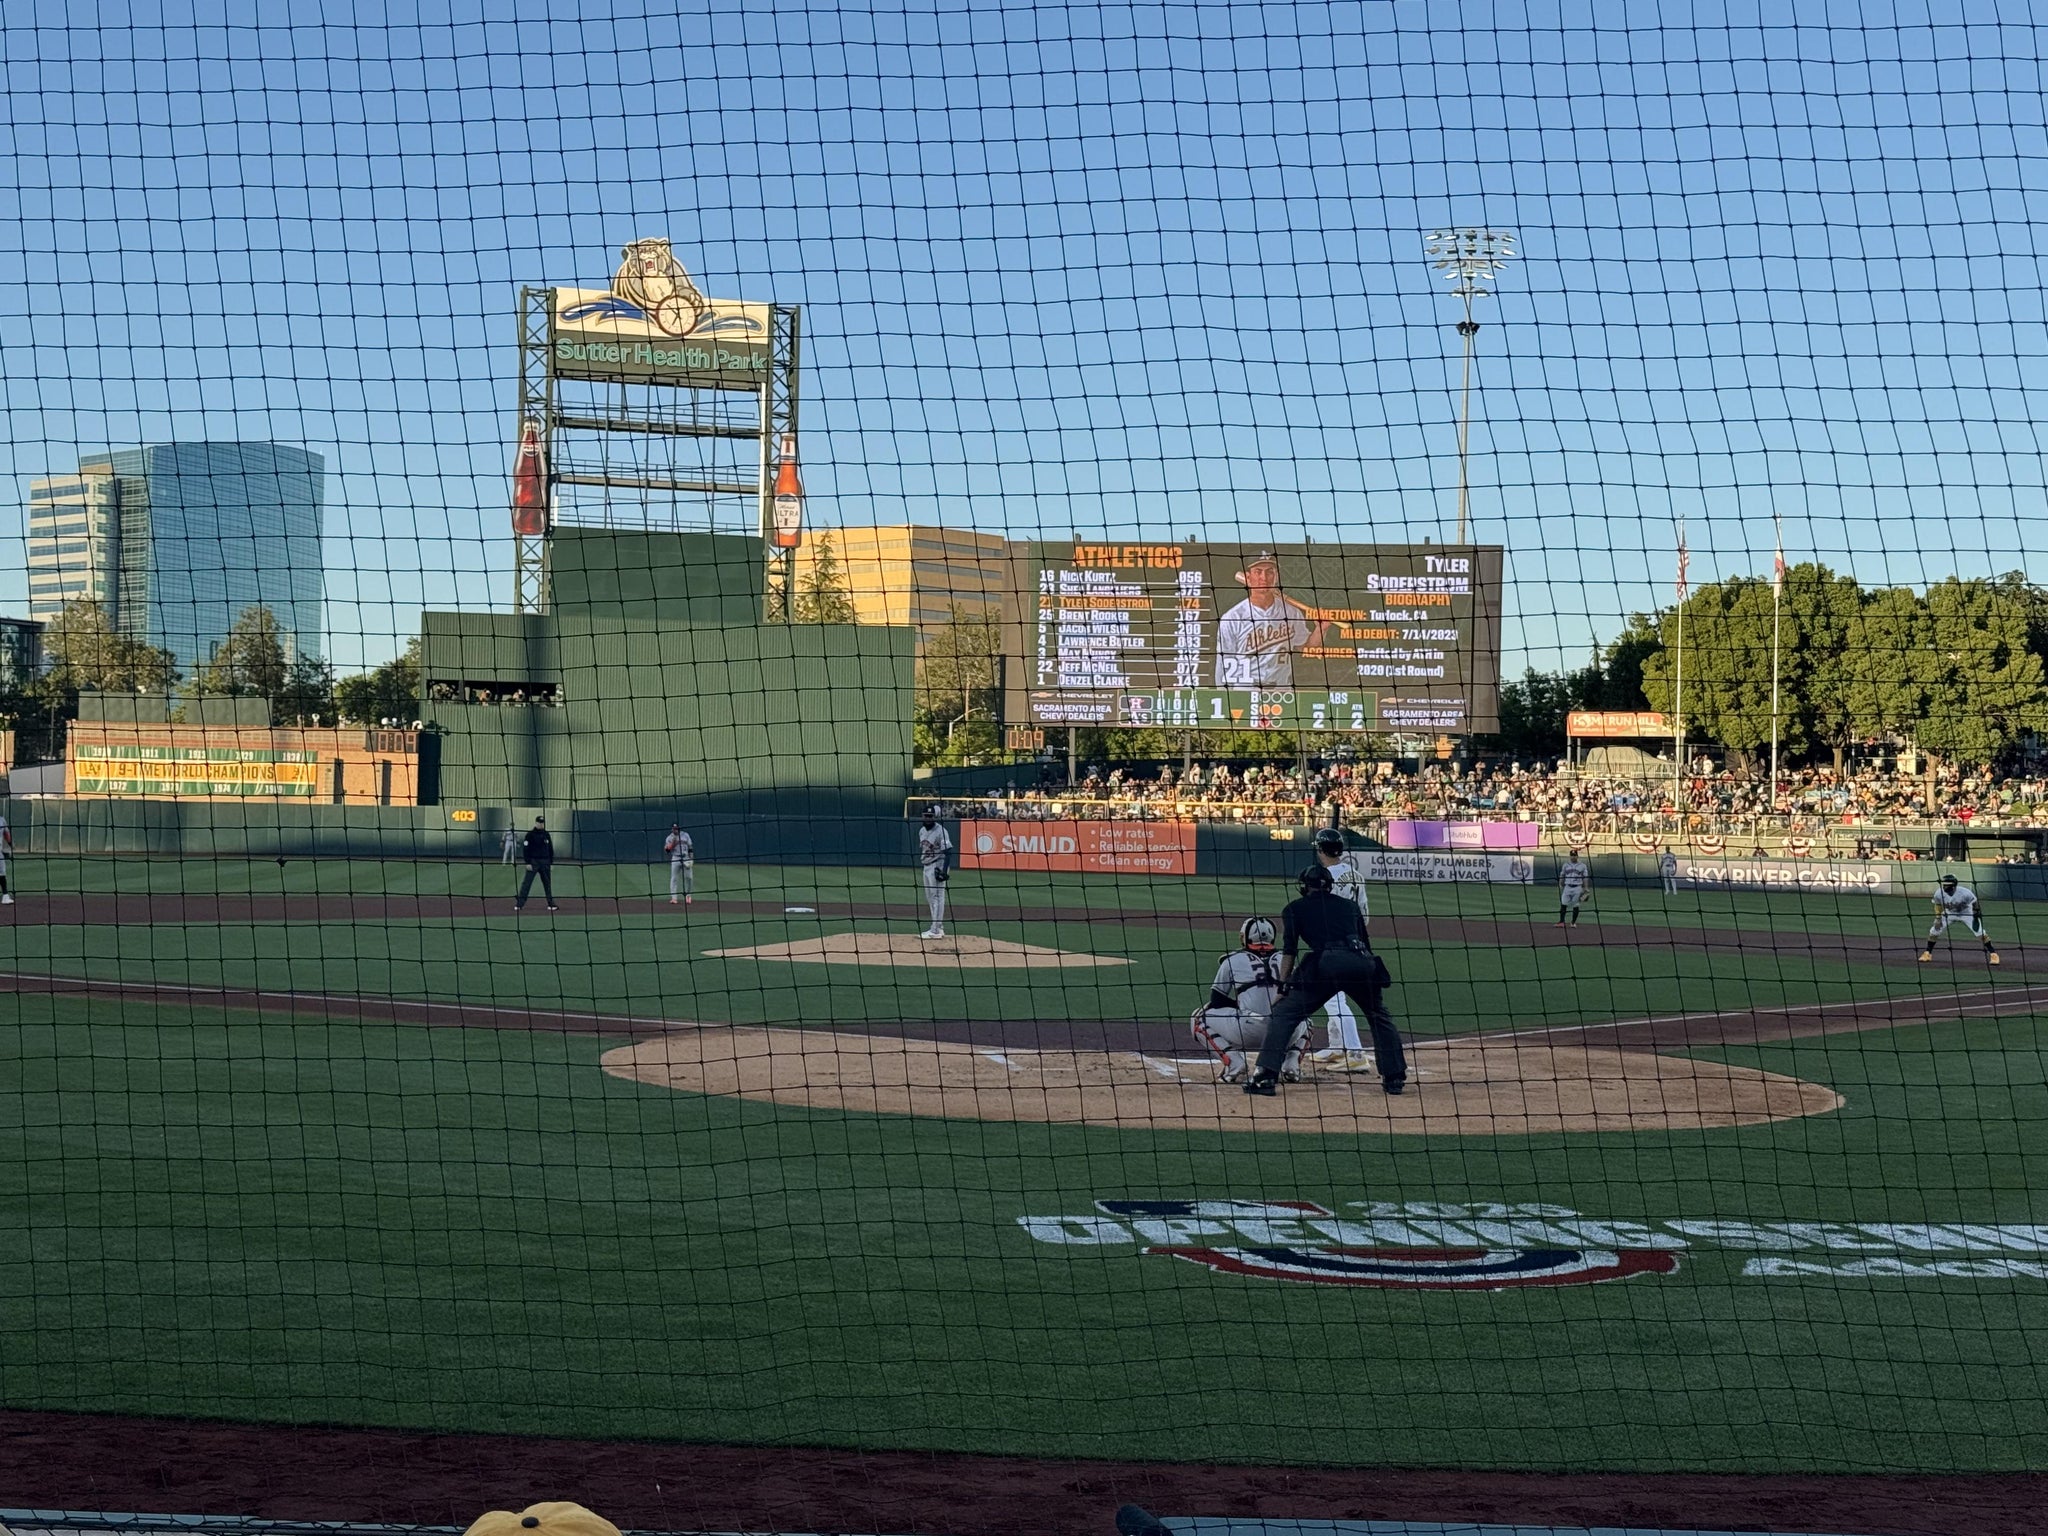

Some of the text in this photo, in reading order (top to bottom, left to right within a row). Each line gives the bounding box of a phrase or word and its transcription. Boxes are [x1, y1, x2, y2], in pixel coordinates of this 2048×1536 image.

[556, 337, 768, 373] Sutter Health Park
[1071, 546, 1183, 568] ATHLETICS
[1424, 556, 1469, 573] TYLER
[1040, 570, 1202, 583] 16 NICK KURTZ .056
[1367, 574, 1469, 592] SODERSTROM
[1385, 594, 1453, 606] BIOGRAPHY
[1039, 610, 1053, 621] 25
[1059, 610, 1089, 621] BRENT
[1091, 610, 1129, 622] ROOKER
[1306, 608, 1367, 620] HOMETOWN:
[1039, 621, 1046, 633] 5
[1038, 635, 1046, 646] 4
[1340, 629, 1362, 640] MLB
[1363, 629, 1400, 640] DEBUT:
[1038, 661, 1053, 672] 22
[1058, 661, 1081, 673] JEFF
[1222, 658, 1254, 683] 21
[1407, 665, 1444, 678] Round)
[1037, 674, 1045, 685] 1
[1329, 692, 1348, 704] ABS
[1033, 704, 1112, 713] SACRAMENTO AREA
[1211, 698, 1225, 719] 1
[1382, 709, 1440, 718] SACRAMENTO
[1040, 712, 1104, 721] CHEVY DEALERS
[1389, 718, 1418, 726] CHEVY
[1609, 716, 1632, 726] RUN
[119, 763, 275, 780] 9-TME WORLD CHAMPIONS
[452, 810, 476, 821] 403
[1100, 827, 1154, 838] Low rates
[1001, 836, 1075, 854] SMUD
[1100, 841, 1144, 851] Reliable
[1099, 855, 1173, 869] Clean energy
[1371, 856, 1495, 869] LOCAL 447 PLUMBERS,
[1371, 868, 1487, 880] PIPEFITTERS & HVACR
[1686, 865, 1881, 889] SKY RIVER CASINO
[1016, 1215, 1693, 1249] OPENING
